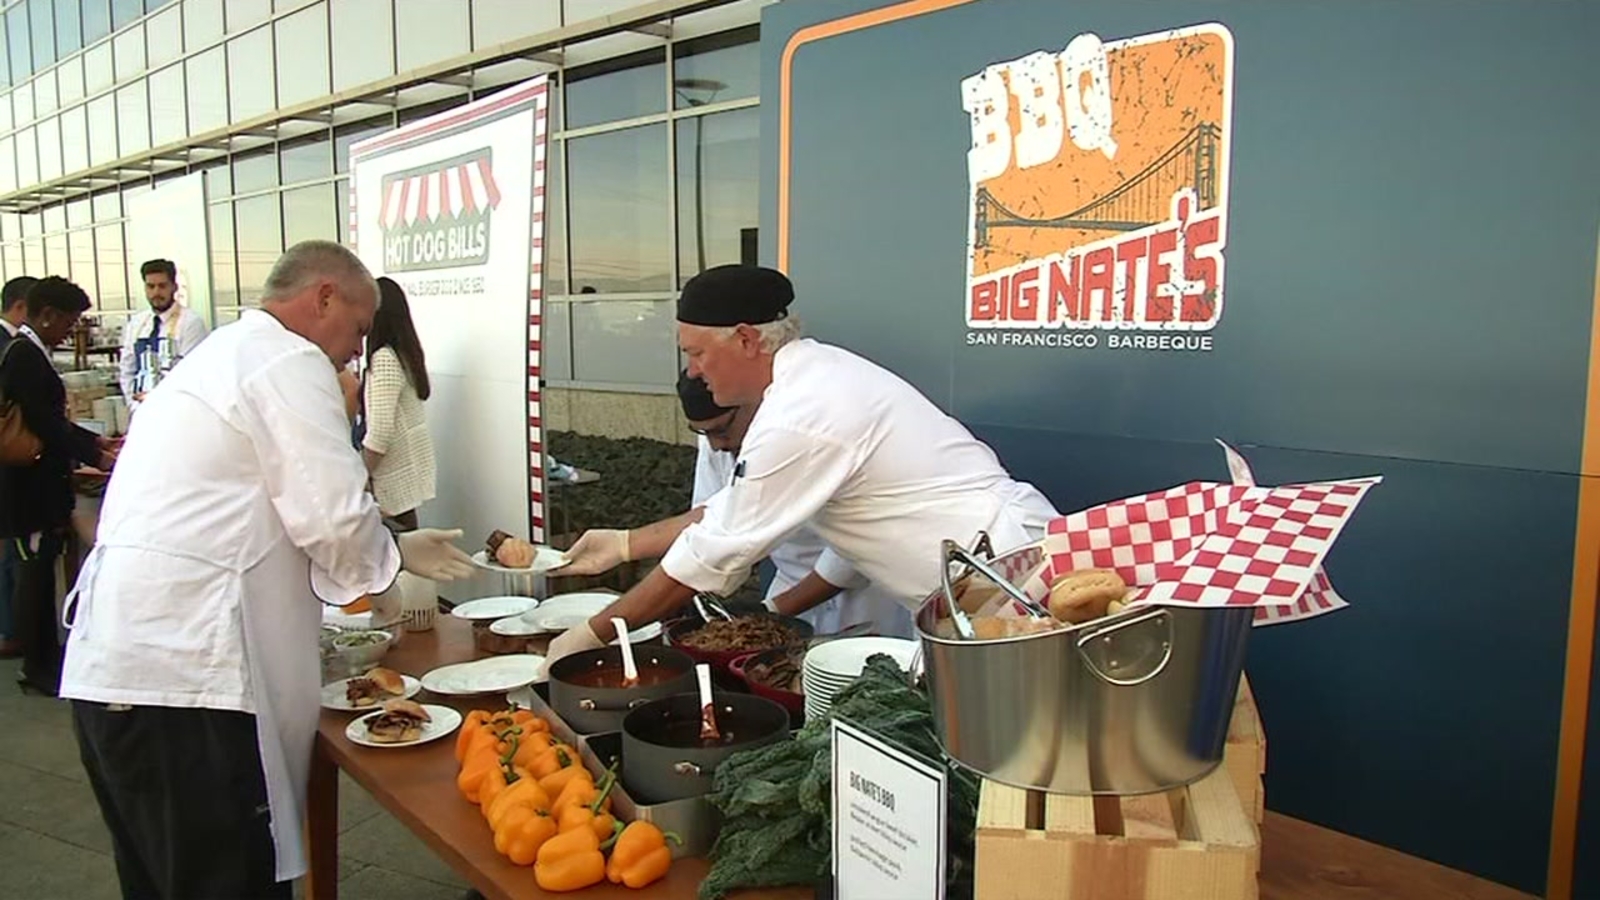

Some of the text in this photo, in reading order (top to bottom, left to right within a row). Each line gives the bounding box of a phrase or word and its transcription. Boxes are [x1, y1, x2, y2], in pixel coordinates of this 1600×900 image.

[961, 32, 1119, 184] BBQ
[385, 221, 486, 268] HOT DOG BILLS
[970, 195, 1220, 323] BIG NATE'S
[966, 332, 1214, 351] SAN FRANCISCO BARBEQUE
